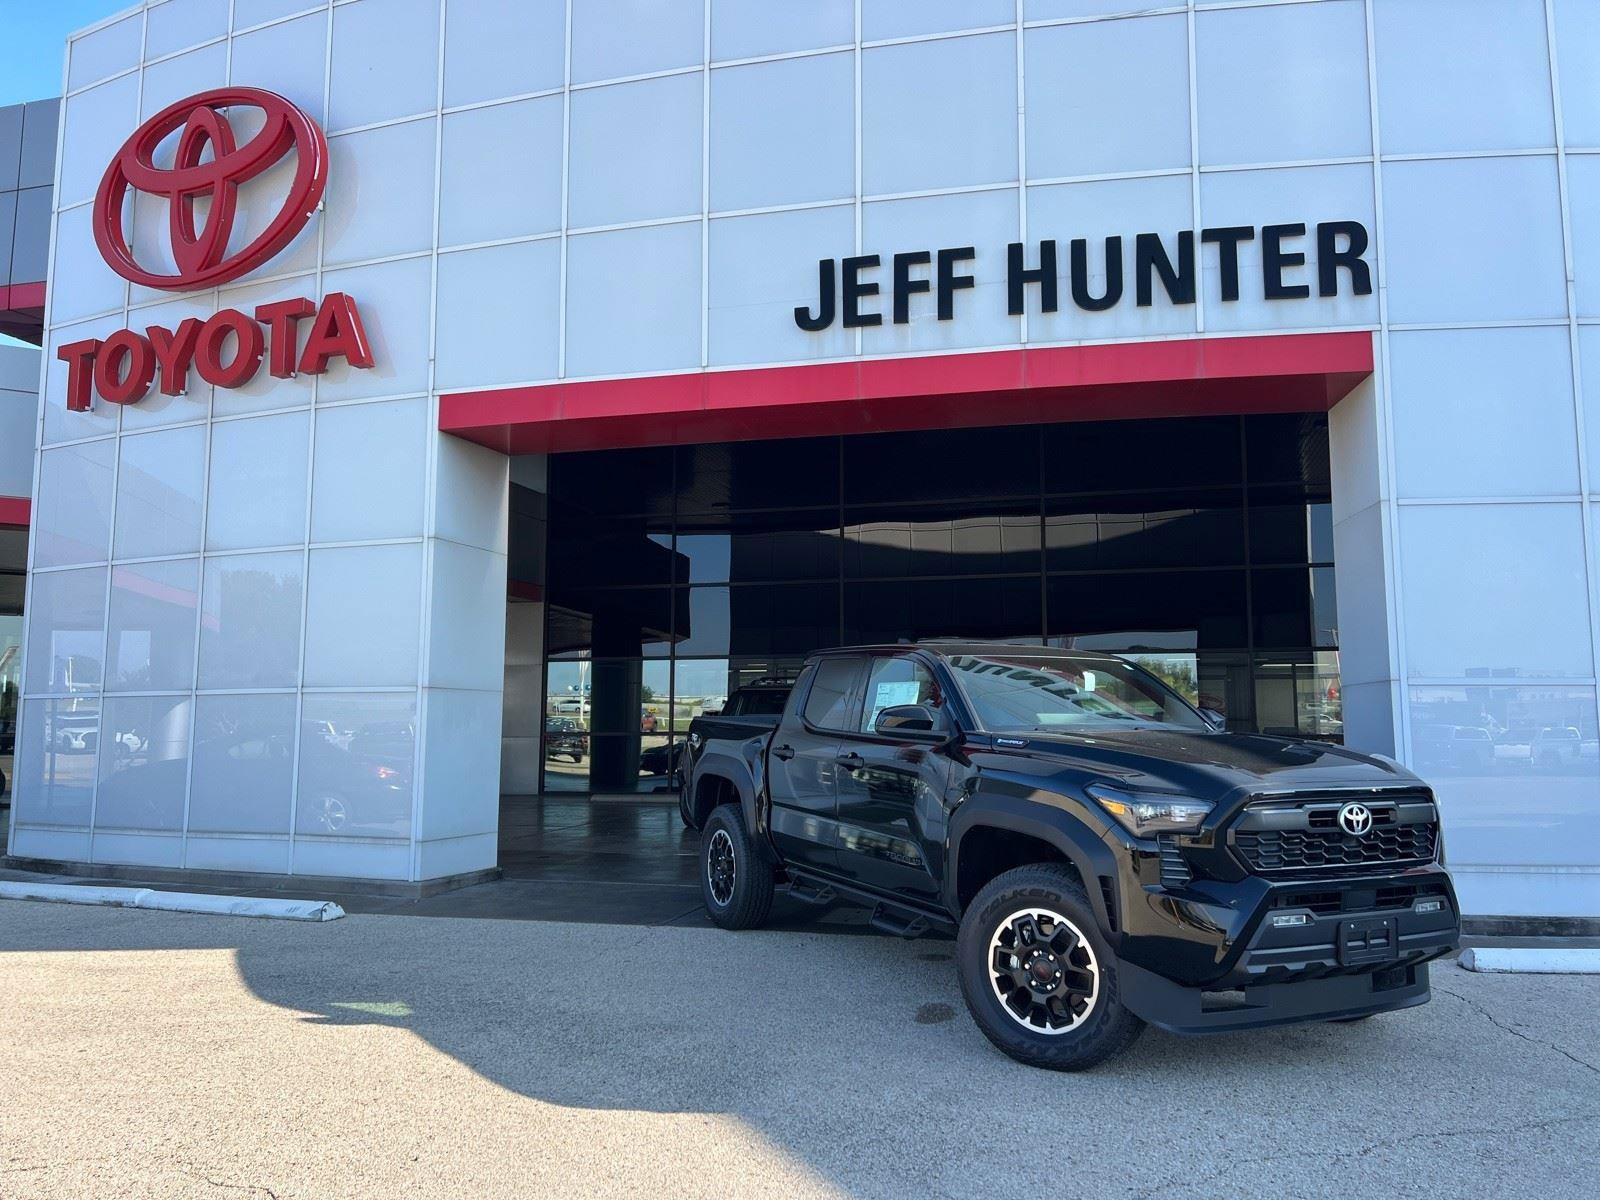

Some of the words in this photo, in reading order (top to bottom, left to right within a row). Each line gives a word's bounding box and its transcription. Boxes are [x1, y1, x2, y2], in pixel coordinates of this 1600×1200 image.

[794, 247, 976, 332] JEFF
[1007, 220, 1373, 316] HUNTER
[58, 292, 375, 412] TOYOTA
